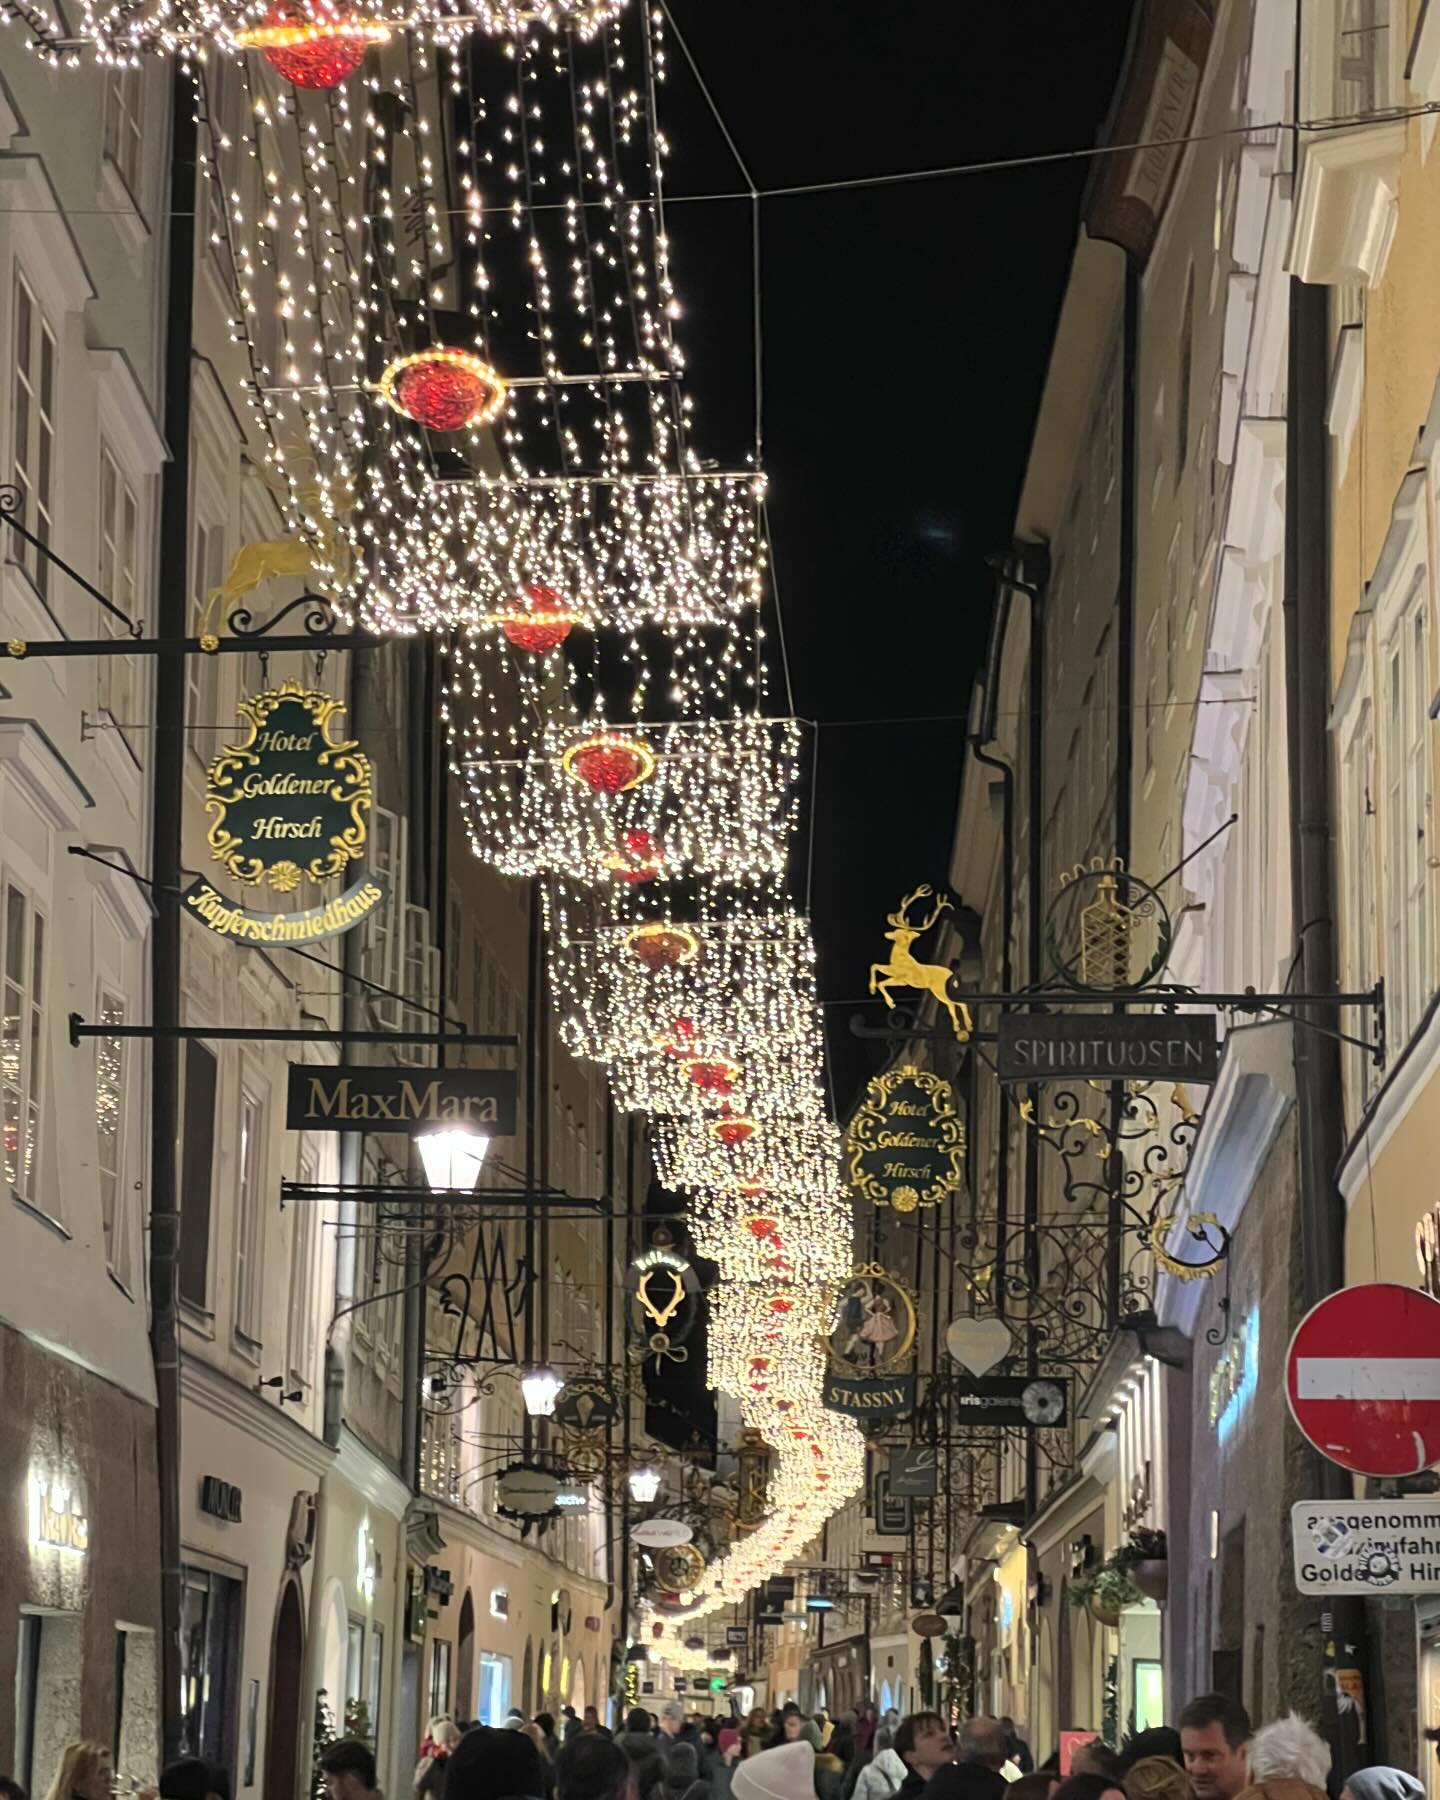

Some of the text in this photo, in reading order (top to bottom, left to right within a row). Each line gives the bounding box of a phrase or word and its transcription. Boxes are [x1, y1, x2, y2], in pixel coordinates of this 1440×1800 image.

[256, 730, 318, 752] Hotel
[243, 773, 335, 798] Goldener
[251, 816, 322, 839] Hirsch
[187, 883, 382, 941] Kupferschmiedhaus
[1014, 1039, 1203, 1067] SPIRITUOSEN
[304, 1077, 498, 1122] MaxMara
[888, 1101, 932, 1117] Hotel
[877, 1131, 940, 1149] Goldener
[882, 1162, 932, 1179] Hirsch
[830, 1387, 906, 1408] STASSNY
